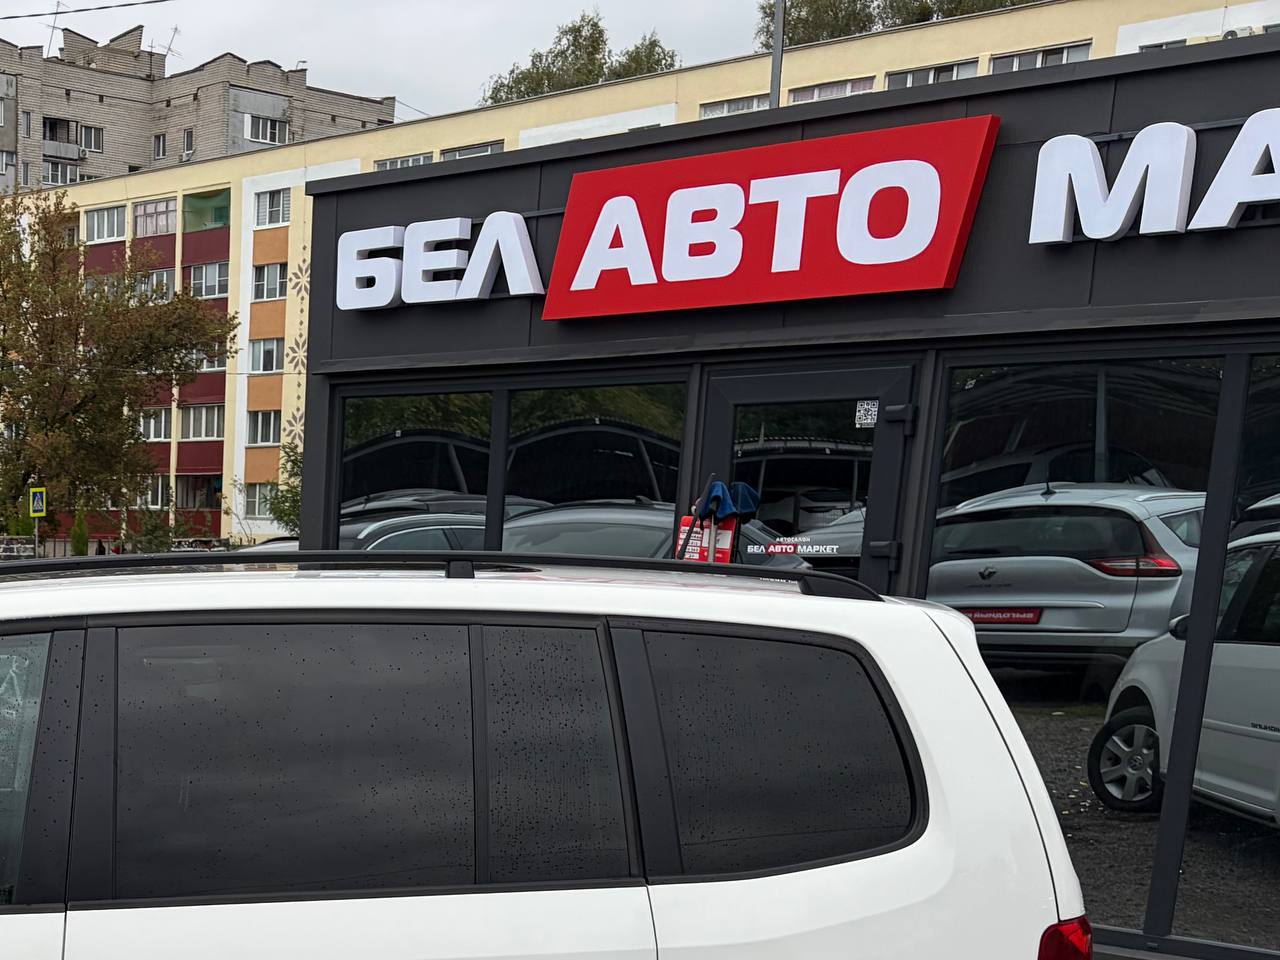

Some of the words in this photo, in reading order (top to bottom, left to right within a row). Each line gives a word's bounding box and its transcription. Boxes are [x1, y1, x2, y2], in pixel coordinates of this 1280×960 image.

[337, 210, 545, 311] БЕЛ
[570, 159, 942, 291] АВТО
[747, 544, 766, 554] БЕЛ
[768, 544, 795, 554] АВТО
[797, 544, 839, 555] МАРКЕТ
